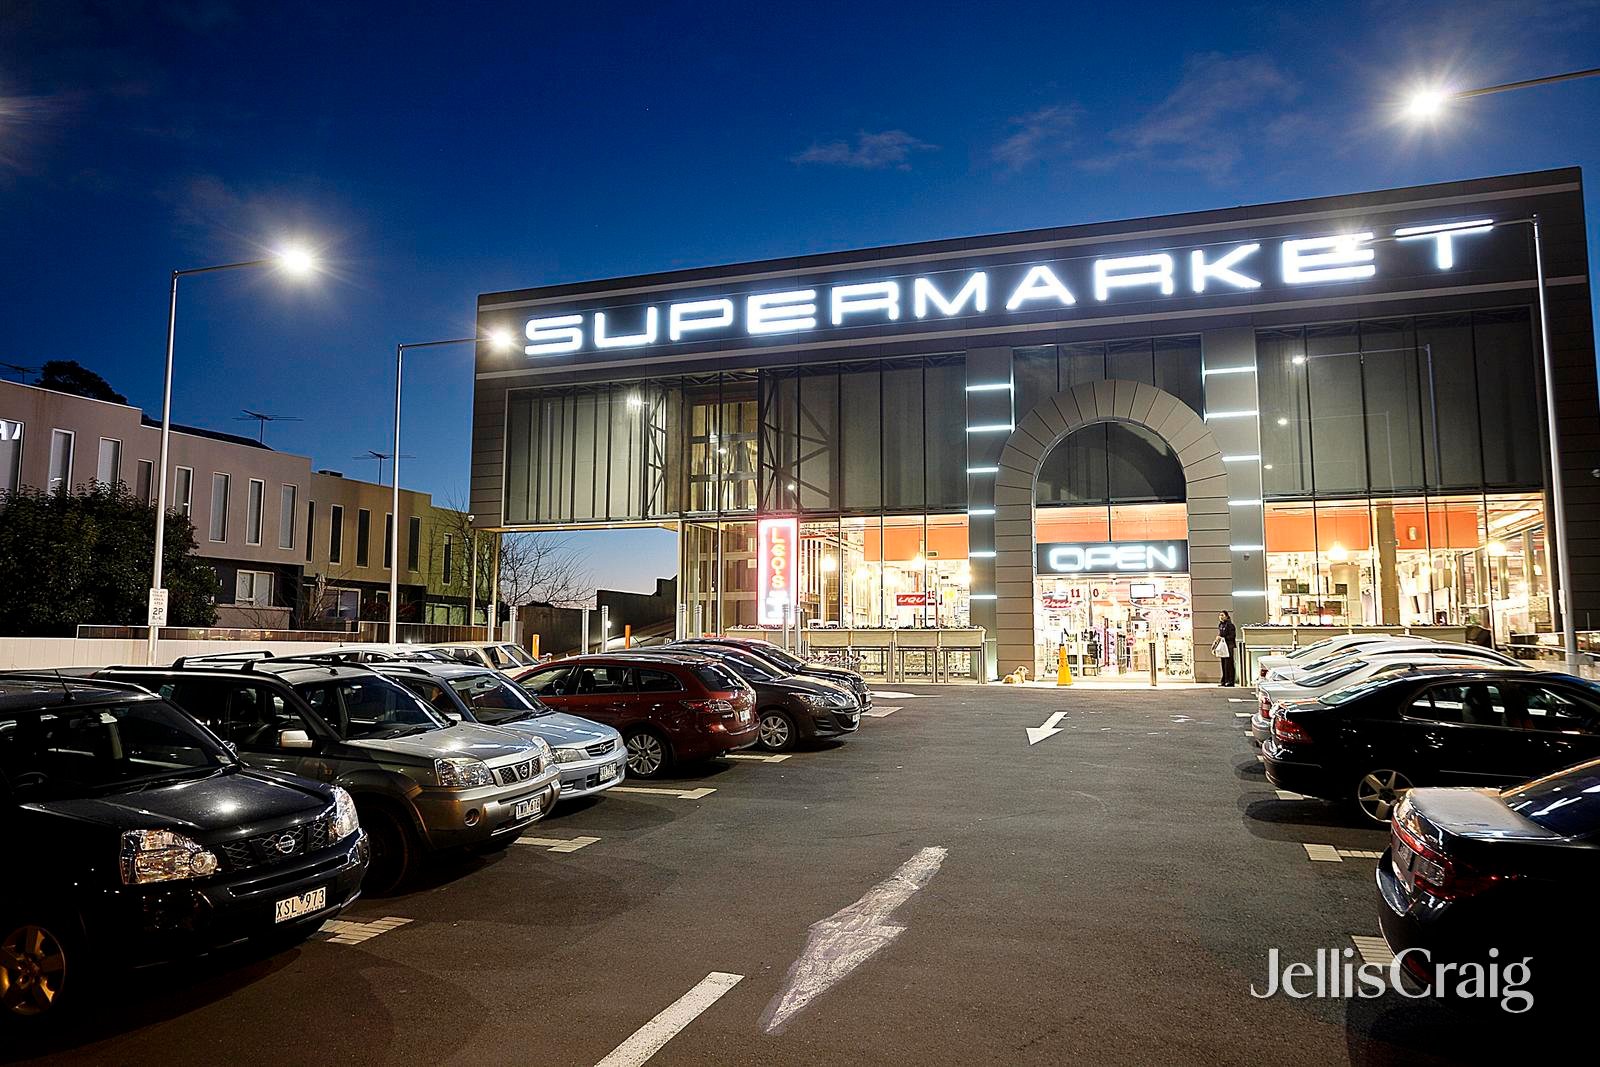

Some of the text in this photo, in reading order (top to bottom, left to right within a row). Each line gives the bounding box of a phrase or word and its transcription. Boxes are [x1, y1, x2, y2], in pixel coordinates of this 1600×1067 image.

[525, 219, 1494, 355] SUPERMARKET
[1050, 546, 1177, 571] OPEN
[152, 607, 164, 615] 2P
[276, 898, 297, 918] XSL
[306, 889, 325, 908] 973
